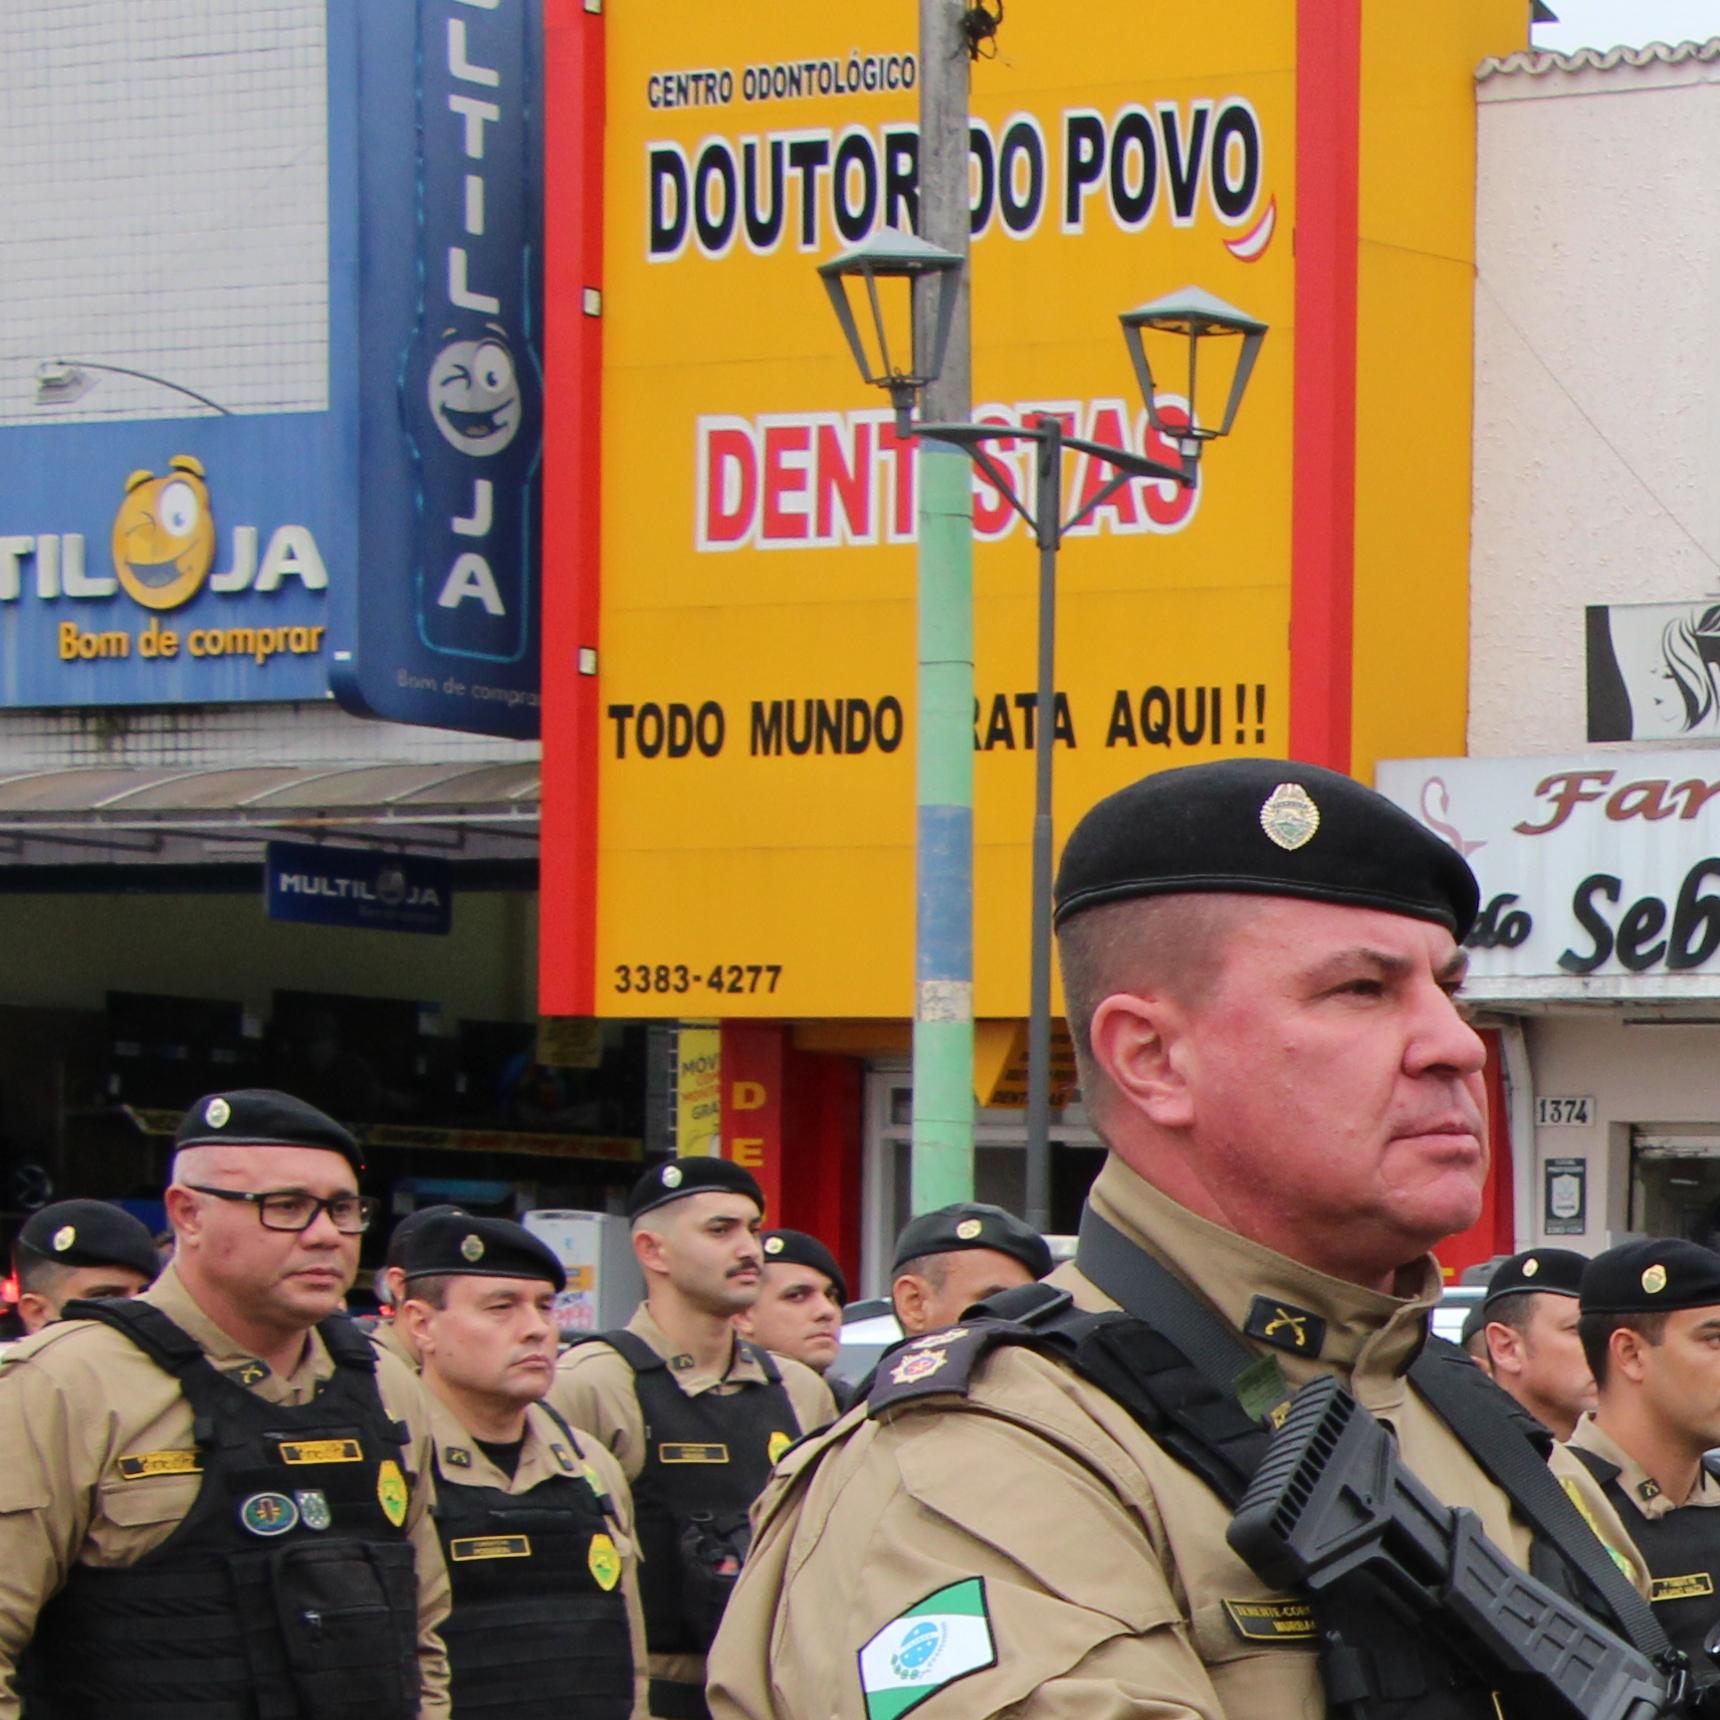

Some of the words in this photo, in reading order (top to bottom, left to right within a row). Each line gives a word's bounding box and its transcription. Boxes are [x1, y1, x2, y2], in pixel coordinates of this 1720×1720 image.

[648, 71, 733, 108] CENTRO
[743, 50, 916, 100] ODONTOLÓGICO
[648, 127, 920, 258] DOUTOR
[1064, 100, 1261, 231] POVO
[701, 398, 1199, 546] DENTSTAS
[58, 620, 131, 660] Bom
[138, 617, 179, 658] de
[187, 624, 325, 667] comprar
[608, 702, 724, 758] TODO
[750, 696, 904, 757] MUNDO
[1476, 893, 1532, 949] do
[614, 964, 783, 995] 3383-4277
[1539, 1099, 1588, 1123] 1374
